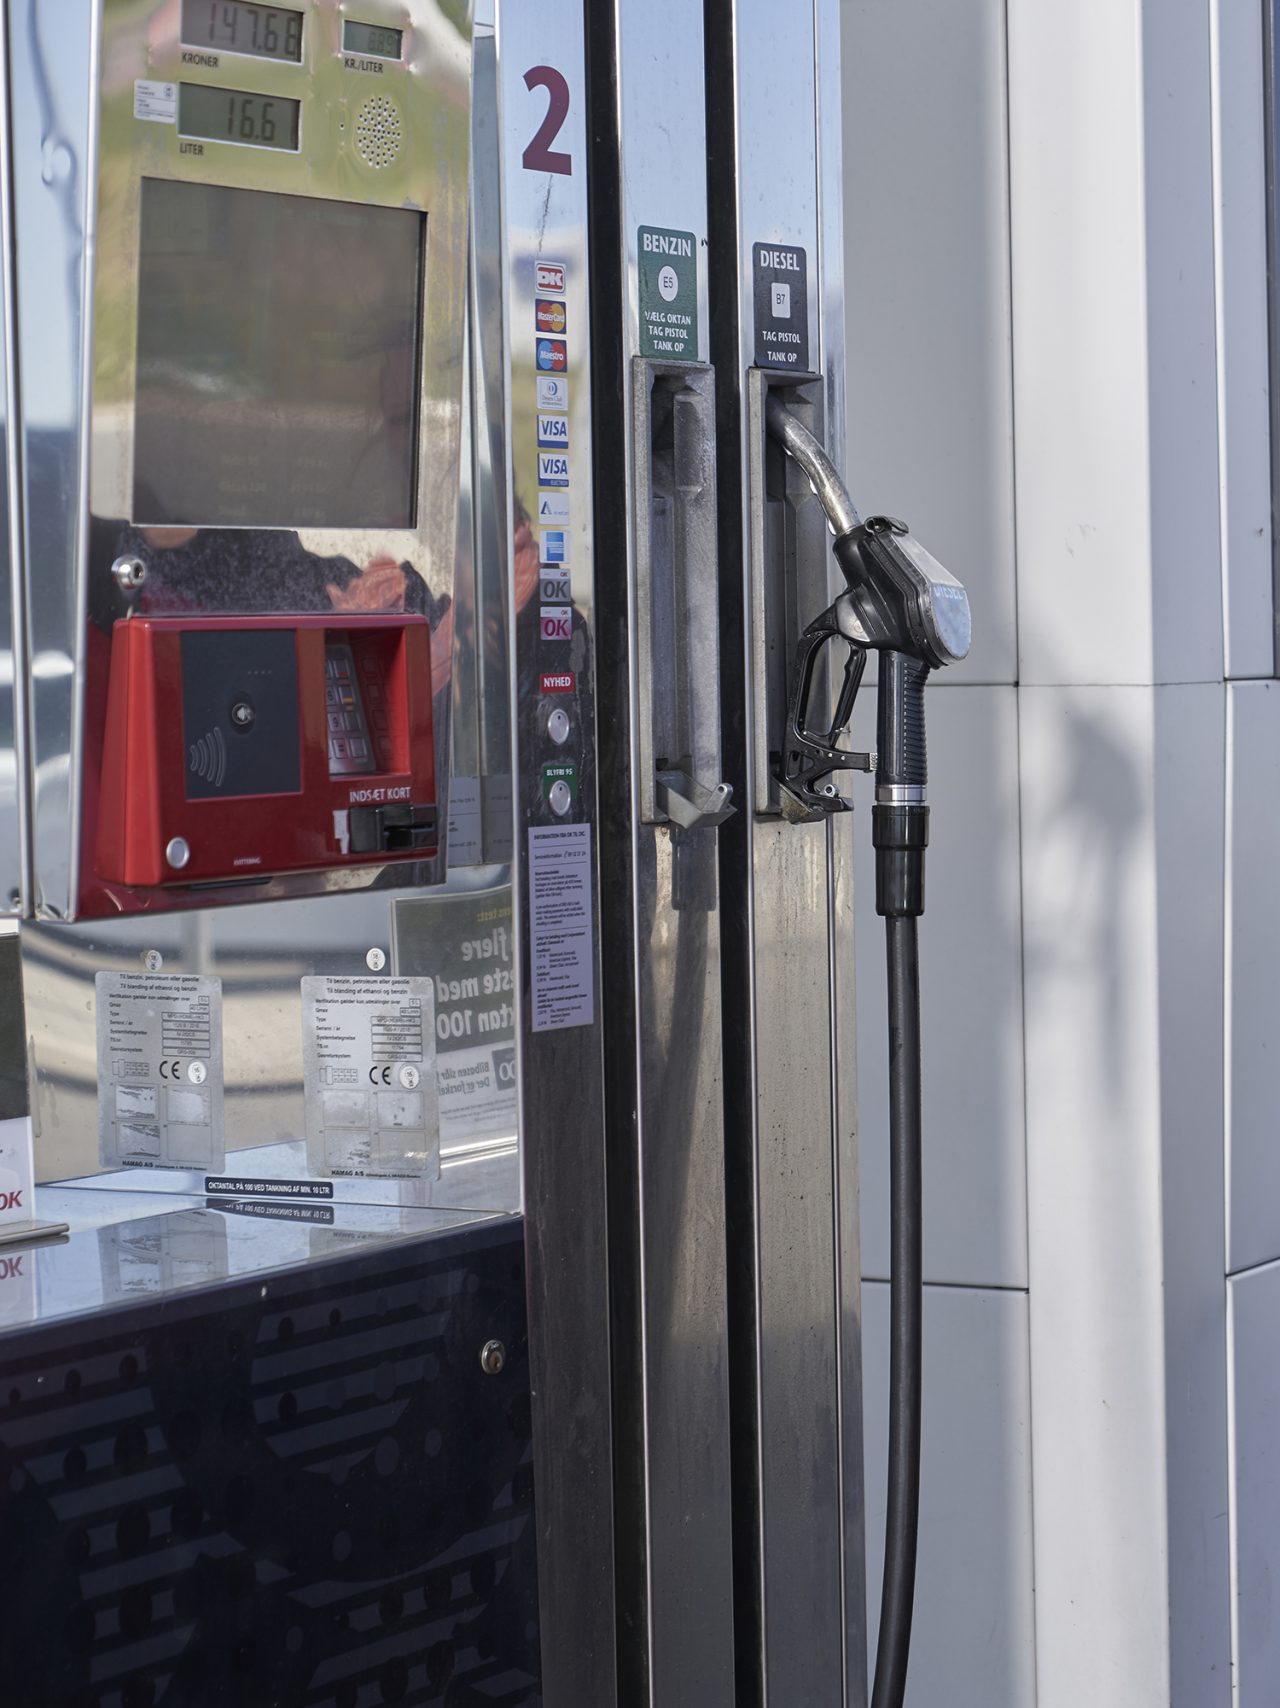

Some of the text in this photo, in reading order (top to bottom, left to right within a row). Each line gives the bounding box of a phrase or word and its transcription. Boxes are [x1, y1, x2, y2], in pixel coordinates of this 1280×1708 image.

[182, 52, 219, 67] KRONER
[344, 57, 384, 73] KR./LITER
[227, 96, 275, 142] 16.6
[522, 65, 572, 176] 2
[179, 142, 204, 156] LITER
[643, 233, 692, 257] BENZIN
[760, 250, 800, 271] DIESEL
[537, 270, 563, 287] DK
[663, 276, 674, 289] E5
[776, 294, 786, 305] B7
[538, 311, 565, 323] MasterCard
[645, 311, 692, 325] VÆLG OKTAN
[649, 325, 688, 339] TAG PISTOL
[762, 331, 800, 343] TAG PISTOL
[653, 340, 684, 352] TANK OP
[540, 350, 564, 361] Maestro
[767, 351, 797, 363] TANK OP
[541, 420, 567, 436] VISA
[542, 458, 568, 474] VISA
[543, 581, 568, 598] OK
[544, 619, 569, 636] OK
[543, 676, 571, 687] NYHED
[349, 786, 411, 803] INDSÆT KORT
[208, 1181, 236, 1191] OKTANTAL
[254, 1183, 265, 1191] VED
[265, 1184, 292, 1193] TANKNING
[292, 1185, 300, 1193] AF
[319, 1186, 330, 1194] LTR
